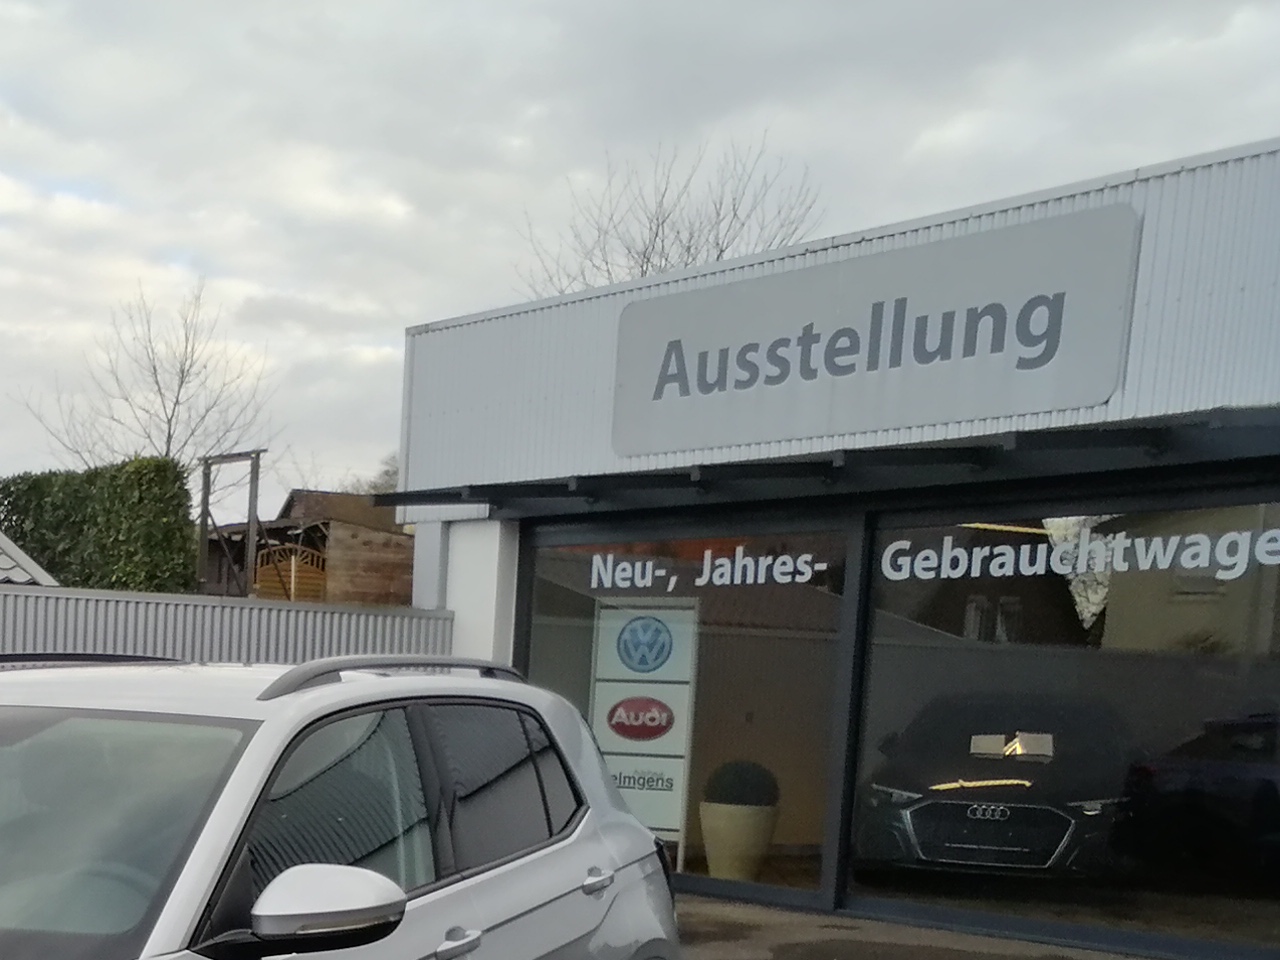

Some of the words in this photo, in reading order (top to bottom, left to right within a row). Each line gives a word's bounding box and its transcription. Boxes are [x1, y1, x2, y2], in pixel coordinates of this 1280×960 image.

[652, 291, 1067, 401] Ausstellung
[590, 553, 678, 592] Neu-,
[694, 545, 828, 587] Jahres-
[881, 526, 1280, 581] Gebrauchtwage
[611, 707, 669, 726] Audi
